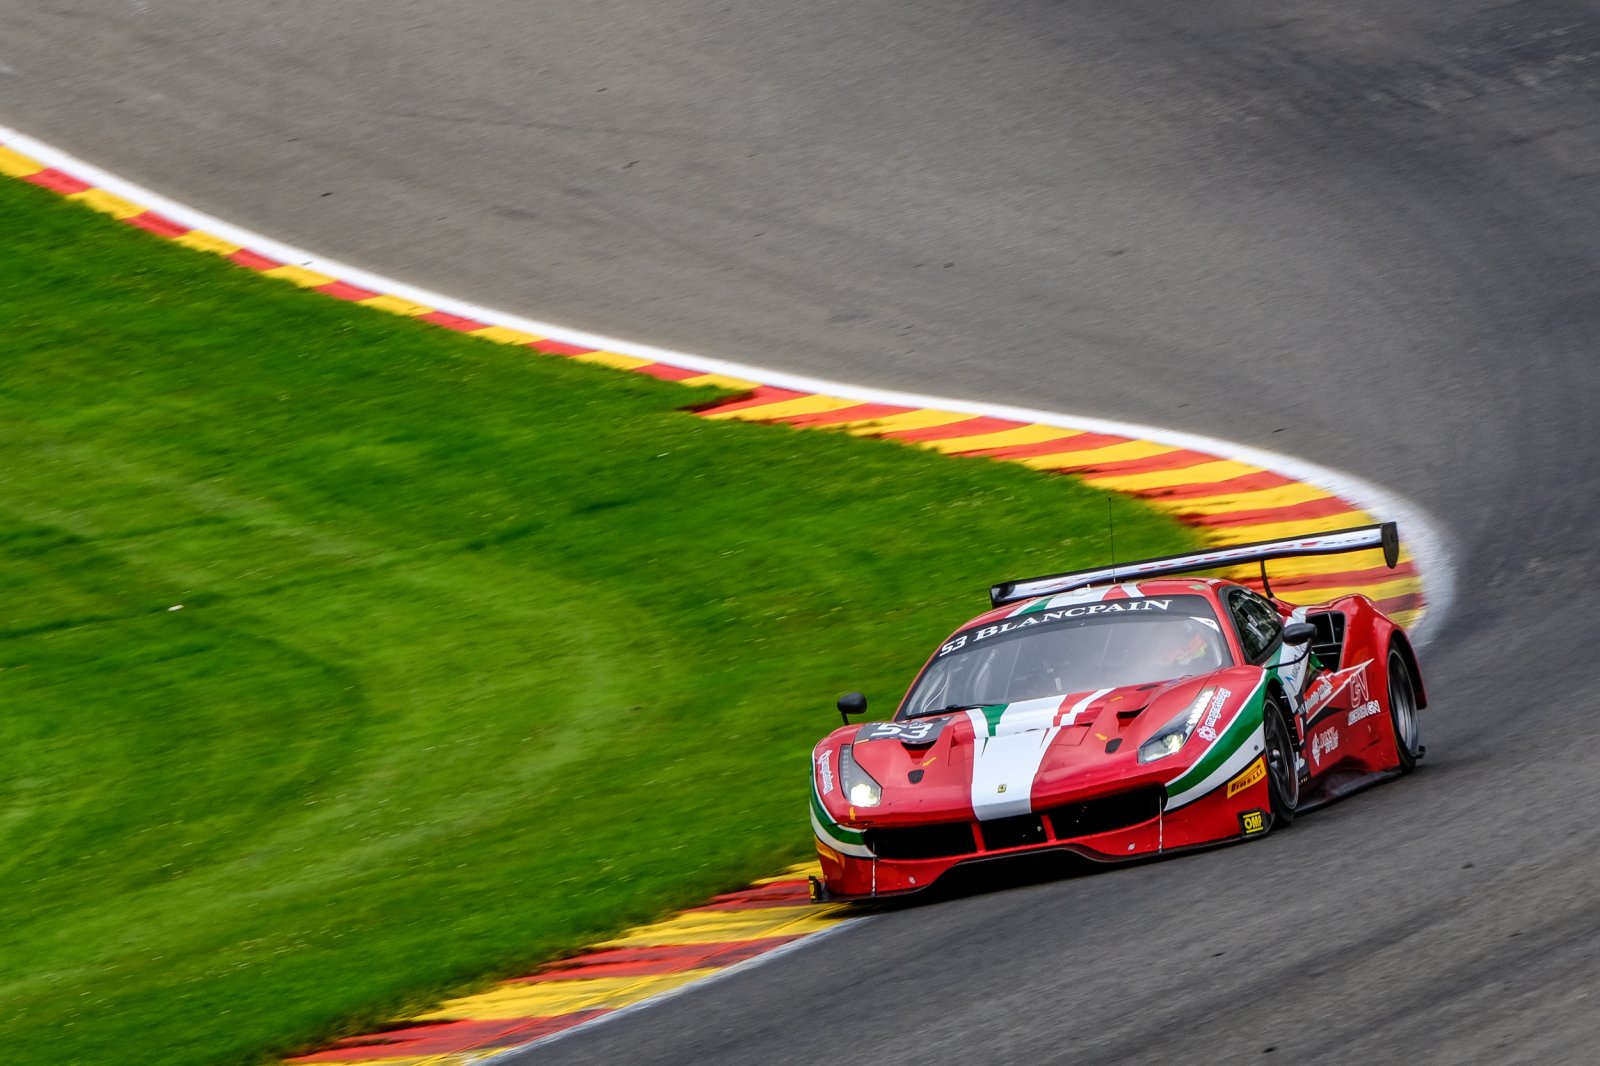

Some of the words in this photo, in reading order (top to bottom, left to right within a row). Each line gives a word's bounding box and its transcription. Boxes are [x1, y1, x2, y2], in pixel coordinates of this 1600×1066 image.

[939, 635, 967, 657] 53
[973, 600, 1173, 642] BLANCPAIN
[871, 723, 933, 739] 53
[1231, 766, 1263, 793] PIRELLI
[1244, 815, 1262, 830] OMP
